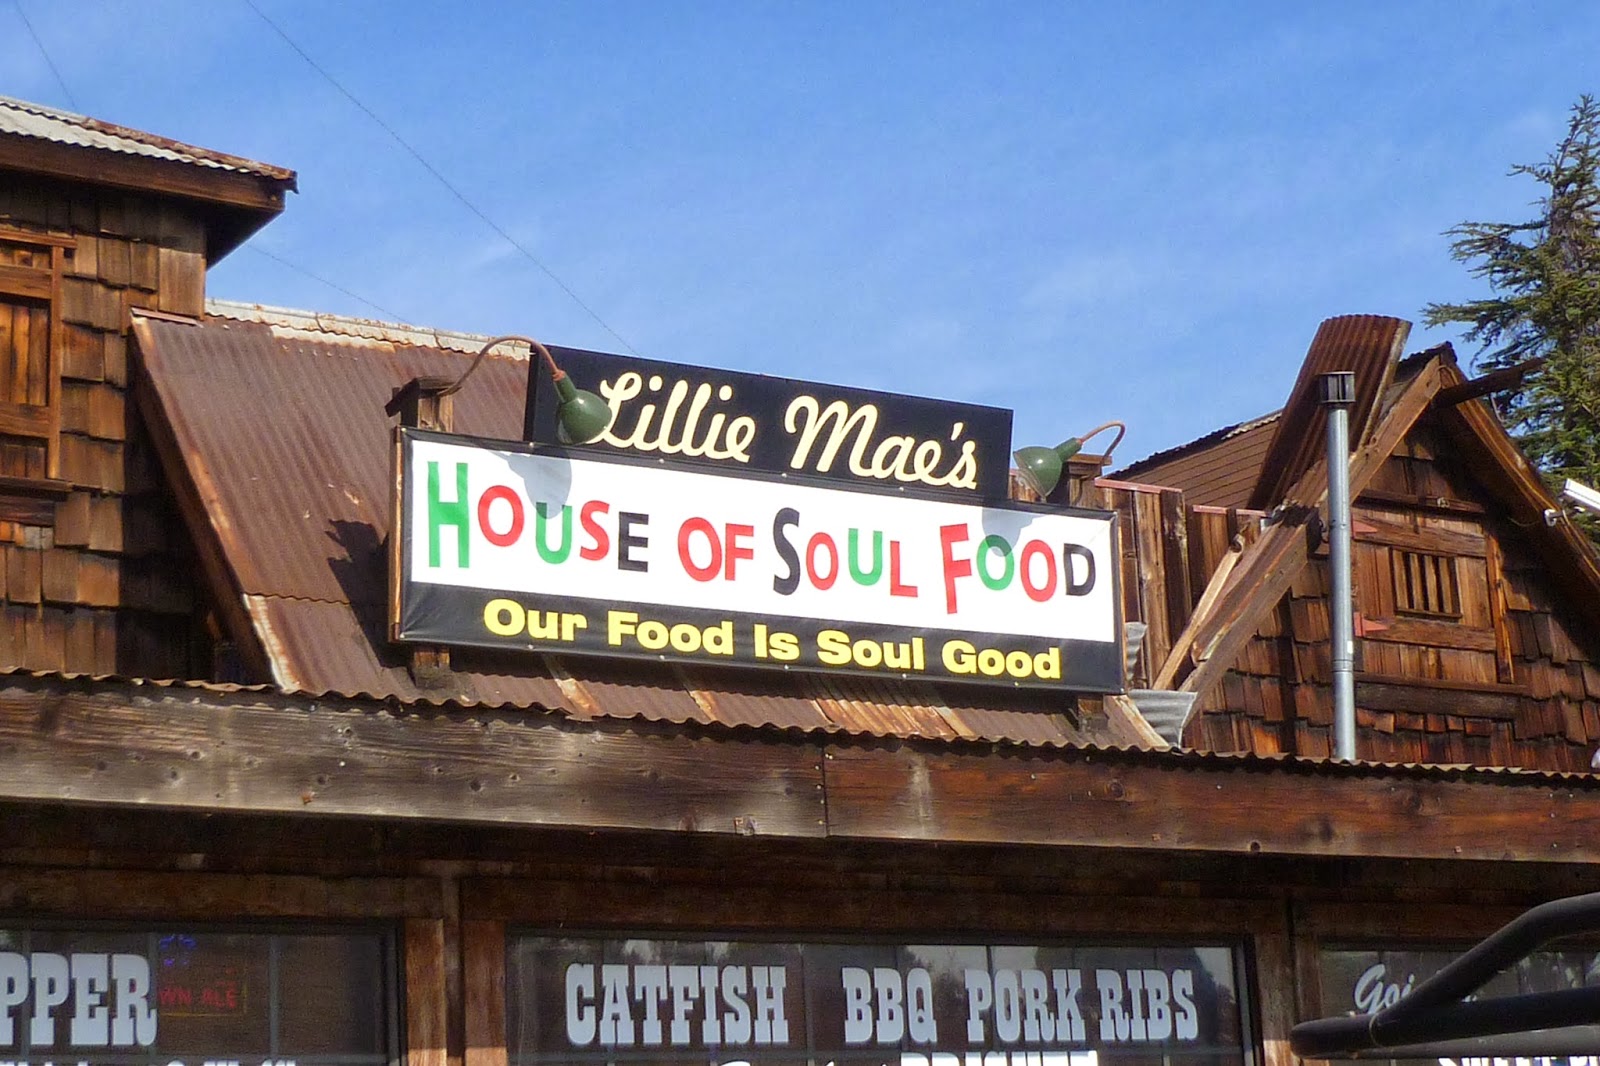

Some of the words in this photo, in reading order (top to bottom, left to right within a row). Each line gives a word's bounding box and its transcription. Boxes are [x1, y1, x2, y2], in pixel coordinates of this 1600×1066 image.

[585, 371, 756, 463] Lillie
[785, 395, 977, 489] Mae's
[427, 461, 649, 573] HOUSE
[678, 517, 754, 582] OF
[773, 507, 918, 598] SOUL
[940, 523, 1096, 614] FOOD
[483, 598, 588, 642] Our
[607, 610, 735, 656] Food
[754, 624, 800, 660] Is
[816, 629, 926, 671] Soul
[941, 639, 1062, 679] Good
[565, 963, 790, 1046] CATFISH
[841, 966, 938, 1043] BBQ
[964, 968, 1086, 1043] PORK
[1096, 968, 1199, 1042] RIBS
